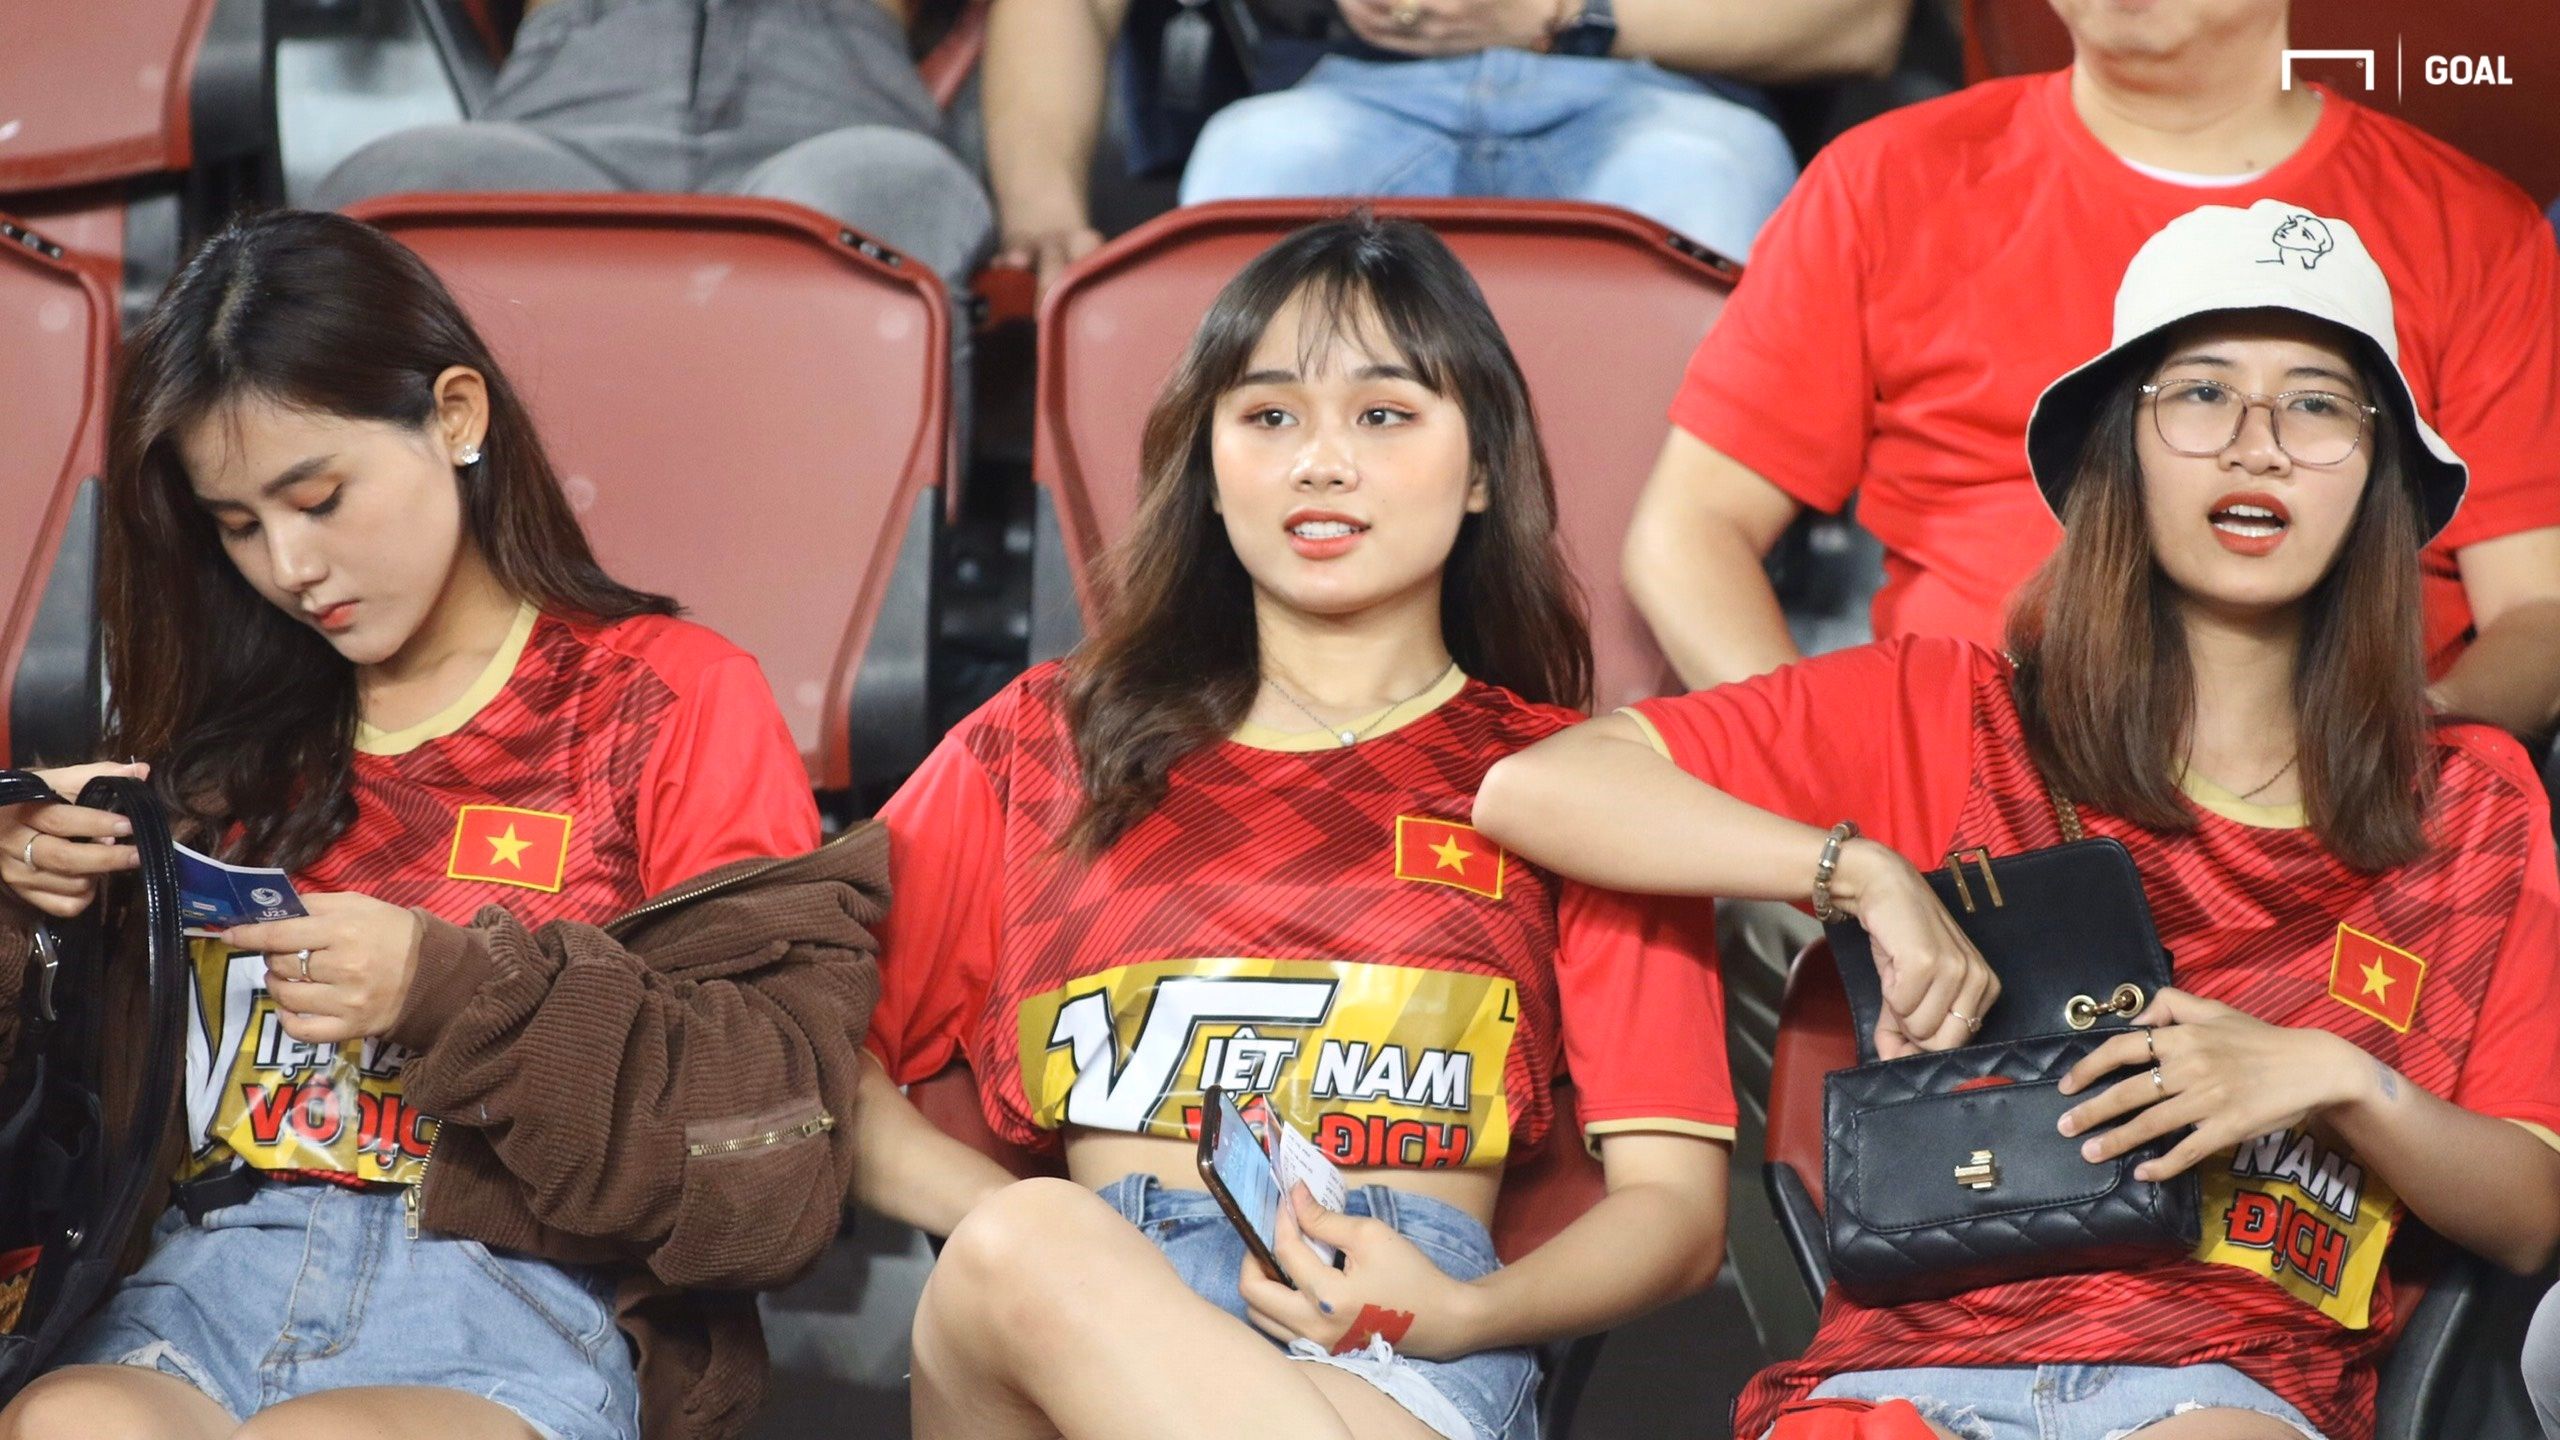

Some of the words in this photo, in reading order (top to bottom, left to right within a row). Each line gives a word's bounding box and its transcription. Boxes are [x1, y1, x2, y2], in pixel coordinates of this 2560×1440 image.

[1311, 1038, 1471, 1112] NAM
[2231, 1127, 2362, 1224] NAM
[2223, 1188, 2350, 1297] ĐỊCH
